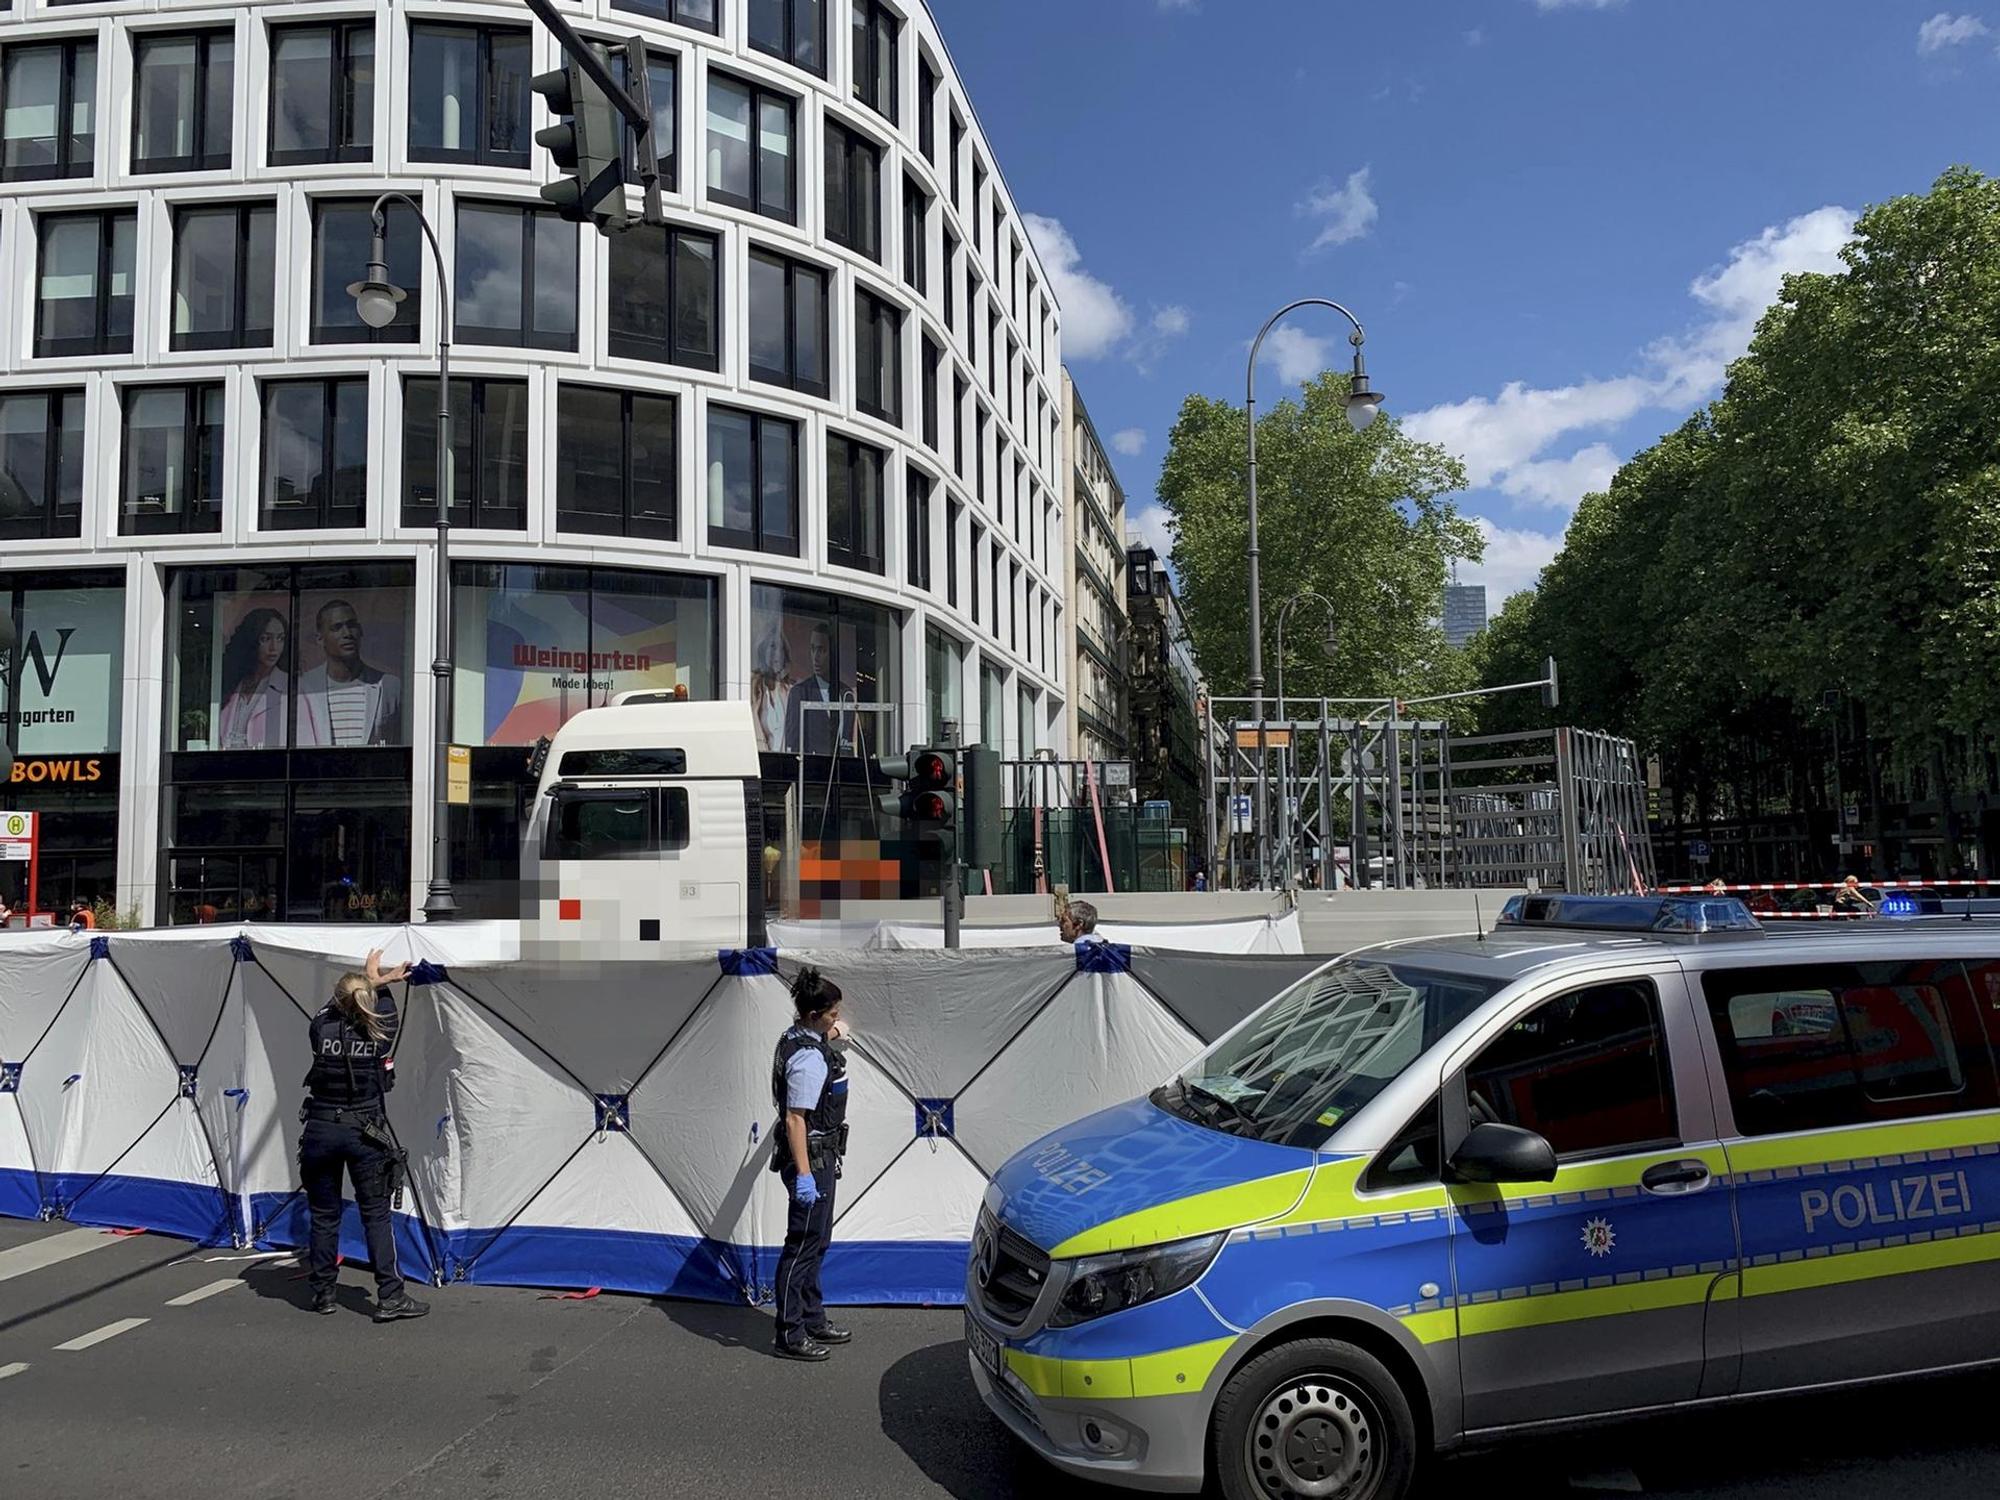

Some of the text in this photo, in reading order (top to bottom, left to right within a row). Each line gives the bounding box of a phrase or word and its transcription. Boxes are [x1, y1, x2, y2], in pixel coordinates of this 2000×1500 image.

[513, 644, 650, 673] Weingarten
[552, 678, 580, 689] Mode
[11, 760, 101, 783] BOWLS
[1027, 1142, 1113, 1196] POLIZEI
[1801, 1171, 1972, 1234] POLIZEI
